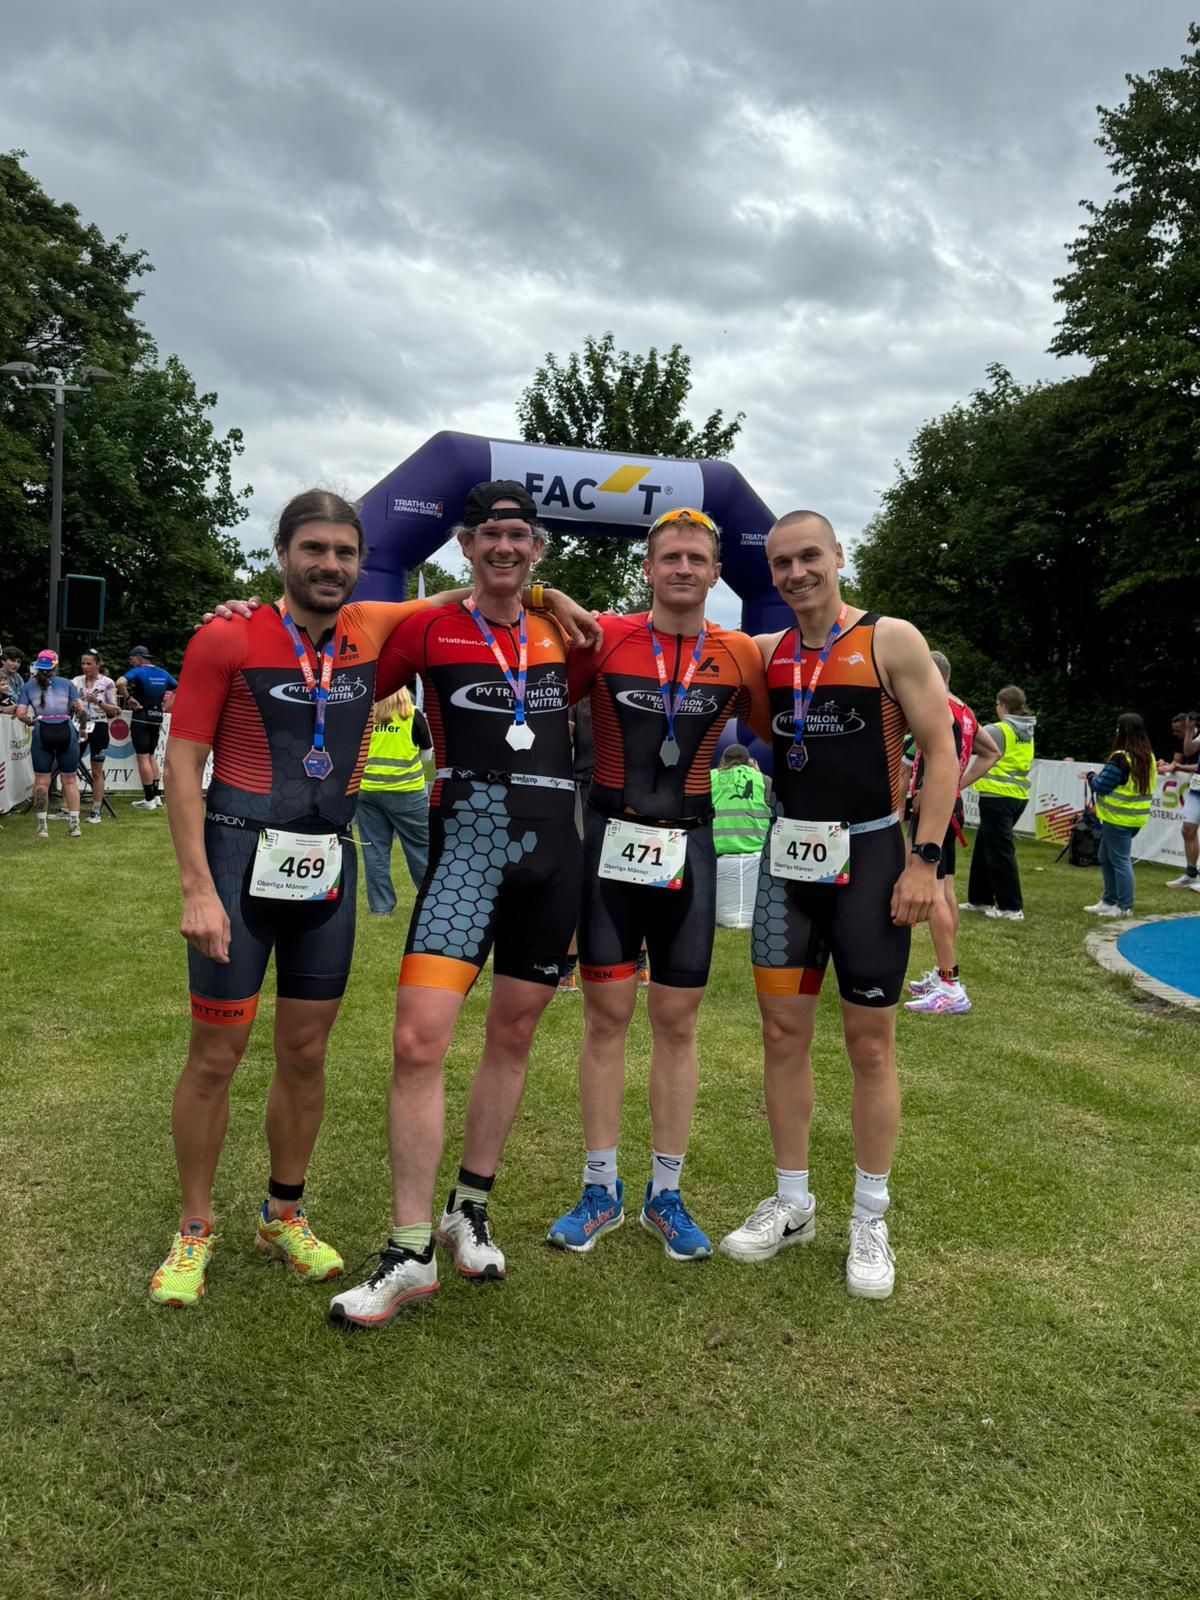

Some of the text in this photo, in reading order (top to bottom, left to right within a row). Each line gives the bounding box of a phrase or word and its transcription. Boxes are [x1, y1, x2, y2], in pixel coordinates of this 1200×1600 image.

[394, 499, 438, 510] TRIATHLON
[476, 687, 493, 697] PV
[633, 692, 645, 700] PV
[528, 697, 563, 708] WITTEN
[807, 723, 845, 732] WITTEN
[621, 842, 663, 867] 471
[786, 841, 827, 863] 470
[279, 857, 325, 879] 469
[604, 863, 626, 873] Oberliga
[627, 866, 649, 876] Männer
[774, 861, 793, 870] Oberliga
[257, 880, 309, 891] Oberliga Männer
[583, 1206, 616, 1237] BROOKS
